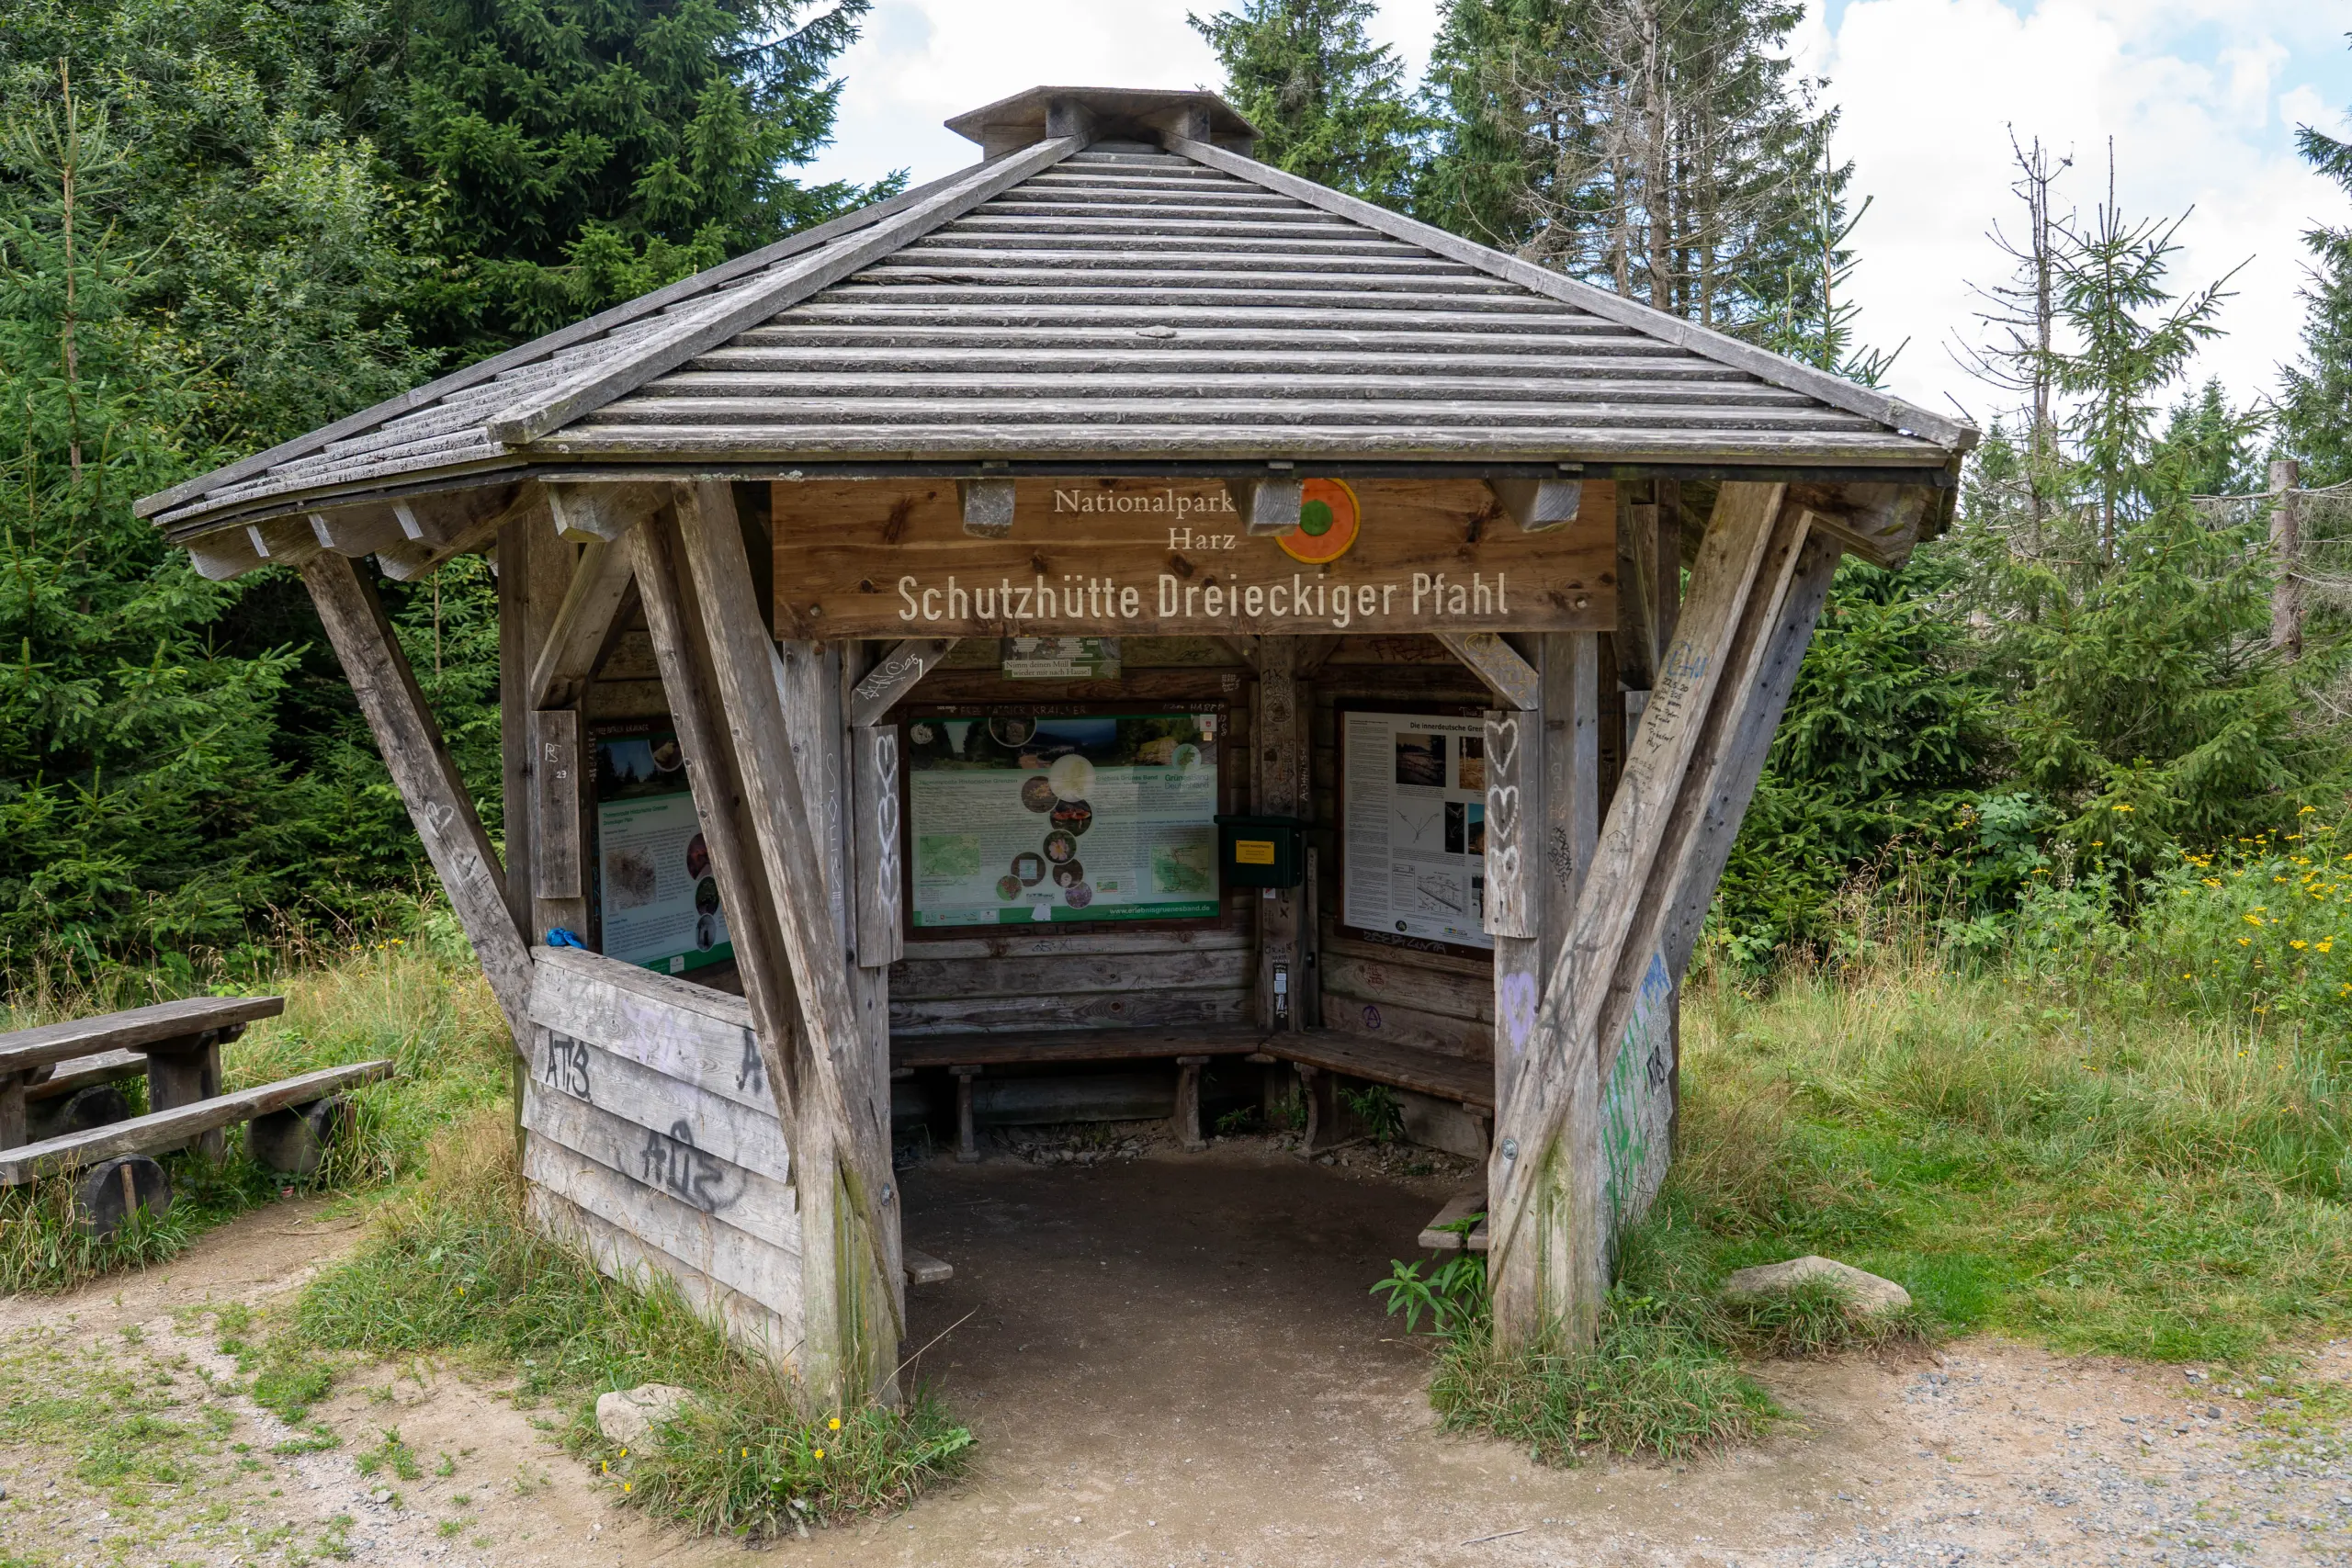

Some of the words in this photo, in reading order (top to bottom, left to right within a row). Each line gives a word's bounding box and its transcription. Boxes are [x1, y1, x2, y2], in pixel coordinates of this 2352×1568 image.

[1054, 489, 1237, 520] Nationalpark
[1168, 527, 1236, 550] Harz
[898, 575, 1140, 621] Schutzhütte
[1159, 573, 1396, 627] Dreieckiger
[1412, 572, 1509, 615] Pfahl
[1006, 660, 1028, 669] Nimm
[1053, 660, 1069, 668] Müll
[1409, 721, 1421, 729] Die
[1421, 722, 1467, 732] innerdeutsche
[1467, 725, 1484, 733] Gren
[556, 770, 567, 779] 23
[1164, 781, 1210, 790] Deutschland
[1109, 904, 1211, 915] www.erlebnisgruenesband.de
